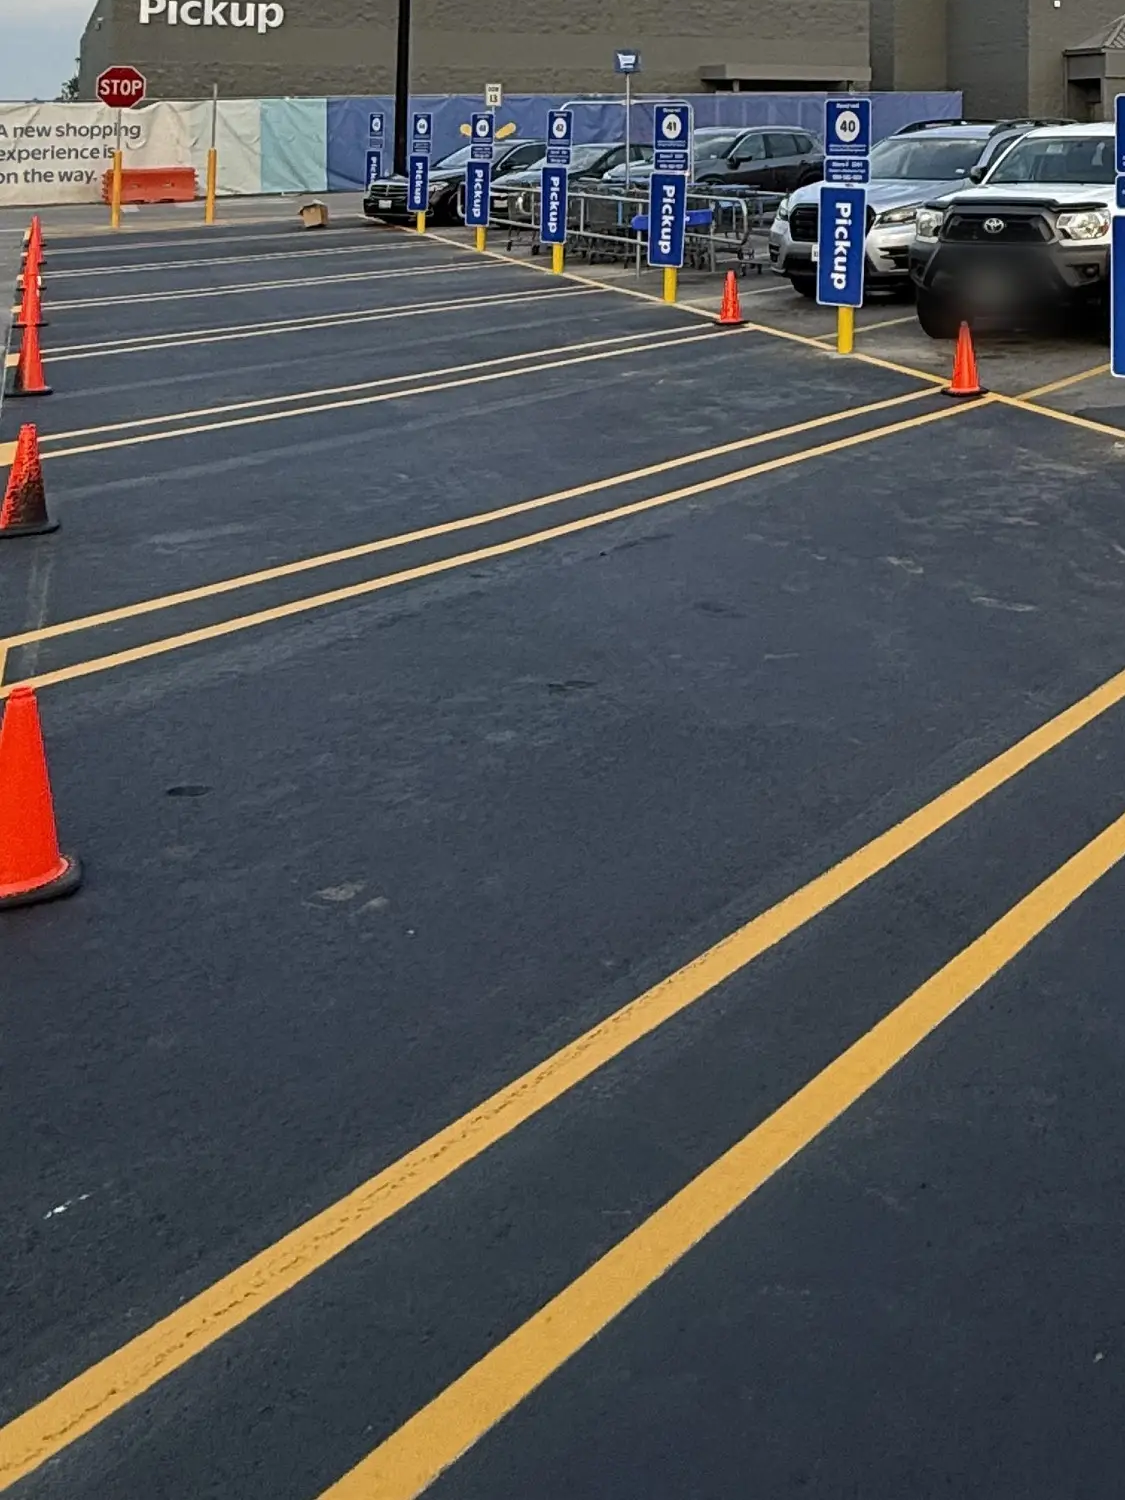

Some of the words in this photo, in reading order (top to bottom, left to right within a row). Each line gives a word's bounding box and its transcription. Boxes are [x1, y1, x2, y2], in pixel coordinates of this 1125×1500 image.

[100, 79, 143, 96] STOP
[0, 124, 8, 137] A
[13, 125, 52, 138] new
[55, 122, 141, 140] shopping
[666, 120, 677, 131] 41
[840, 120, 856, 132] 40
[0, 145, 100, 164] experience
[103, 144, 115, 159] is
[0, 172, 18, 184] on
[23, 168, 54, 183] the
[58, 170, 97, 185] way.
[472, 169, 483, 218] Pickup
[547, 176, 560, 233] Pickup
[658, 185, 675, 254] Pickup
[830, 202, 852, 290] Pickup
